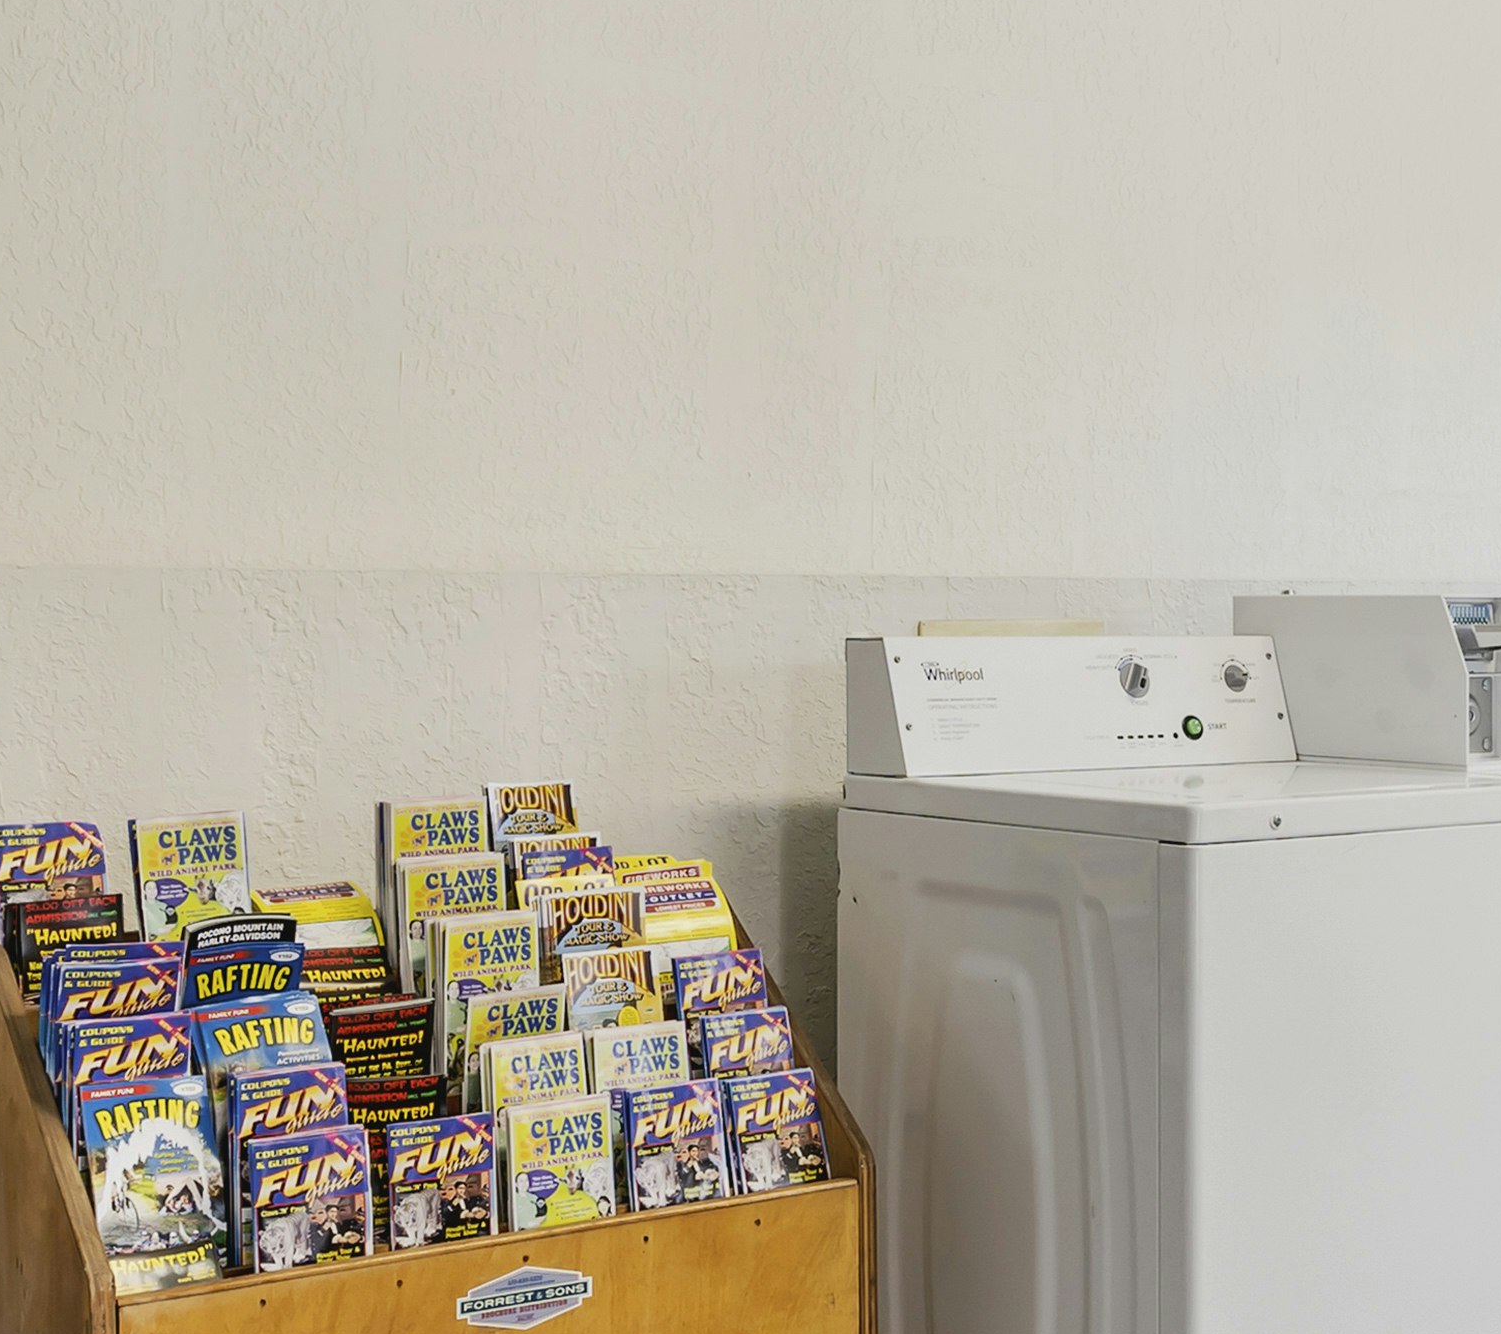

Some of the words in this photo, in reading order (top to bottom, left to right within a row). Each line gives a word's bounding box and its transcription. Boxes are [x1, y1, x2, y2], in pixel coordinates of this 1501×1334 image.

[923, 667, 984, 685] Whirlpool
[1207, 722, 1227, 730] START
[410, 810, 479, 831] CLAWS
[8, 837, 40, 846] GUIDE
[158, 825, 236, 849] CLAWS
[427, 827, 480, 847] PAWS
[178, 843, 237, 865] PAWS
[44, 848, 102, 884] guide
[624, 868, 698, 884] FIREWORKS
[425, 868, 497, 890] CLAWS
[442, 885, 498, 906] PAWS
[649, 892, 702, 903] OUTLET
[552, 892, 634, 937] HOUDINI
[197, 927, 232, 940] POCONO
[233, 923, 284, 933] MOUNTAIN
[463, 926, 531, 949] CLAWS
[564, 935, 595, 946] MAGIC
[597, 932, 630, 942] SHOW
[574, 923, 605, 933] TOUR
[197, 932, 281, 948] HARLEY-DAVIDSON
[71, 949, 126, 958] COUPONS
[479, 944, 531, 966] PAWS
[65, 970, 121, 978] COUPONS
[196, 963, 291, 999] RAFTING
[565, 951, 650, 995] HOUDINI
[58, 976, 165, 1023] FUN
[611, 993, 644, 1002] SHOW
[683, 965, 754, 1011] FUN
[488, 998, 558, 1022] CLAWS
[79, 1026, 134, 1037] COUPONS
[214, 1018, 315, 1056] RAFTING
[502, 1015, 557, 1037] PAWS
[90, 1036, 125, 1046] GUIDE
[612, 1035, 679, 1058] CLAWS
[710, 1024, 780, 1071] FUN
[74, 1033, 178, 1086] FUN
[124, 1047, 185, 1081] guide
[511, 1049, 579, 1075] CLAWS
[629, 1053, 680, 1075] PAWS
[241, 1077, 291, 1091] COUPONS
[529, 1067, 580, 1091] PAWS
[90, 1089, 116, 1098] FAMILY
[252, 1089, 283, 1100] GUIDE
[95, 1099, 200, 1140] RAFTING
[238, 1084, 334, 1138] FUN
[285, 1099, 344, 1135] guide
[736, 1086, 807, 1135] FUN
[773, 1102, 816, 1131] guide
[390, 1125, 441, 1137] COUPONS
[531, 1112, 603, 1139] CLAWS
[633, 1097, 712, 1148] FUN
[671, 1112, 718, 1147] guide
[255, 1145, 309, 1159] COUPONS
[402, 1135, 434, 1146] GUIDE
[549, 1130, 603, 1156] PAWS
[268, 1156, 302, 1169] GUIDE
[389, 1131, 483, 1185] FUN
[437, 1144, 491, 1184] guide
[253, 1152, 355, 1208] FUN
[305, 1166, 364, 1207] guide
[463, 1292, 532, 1312] FORREST
[536, 1290, 544, 1299] &
[545, 1284, 586, 1298] SONS
